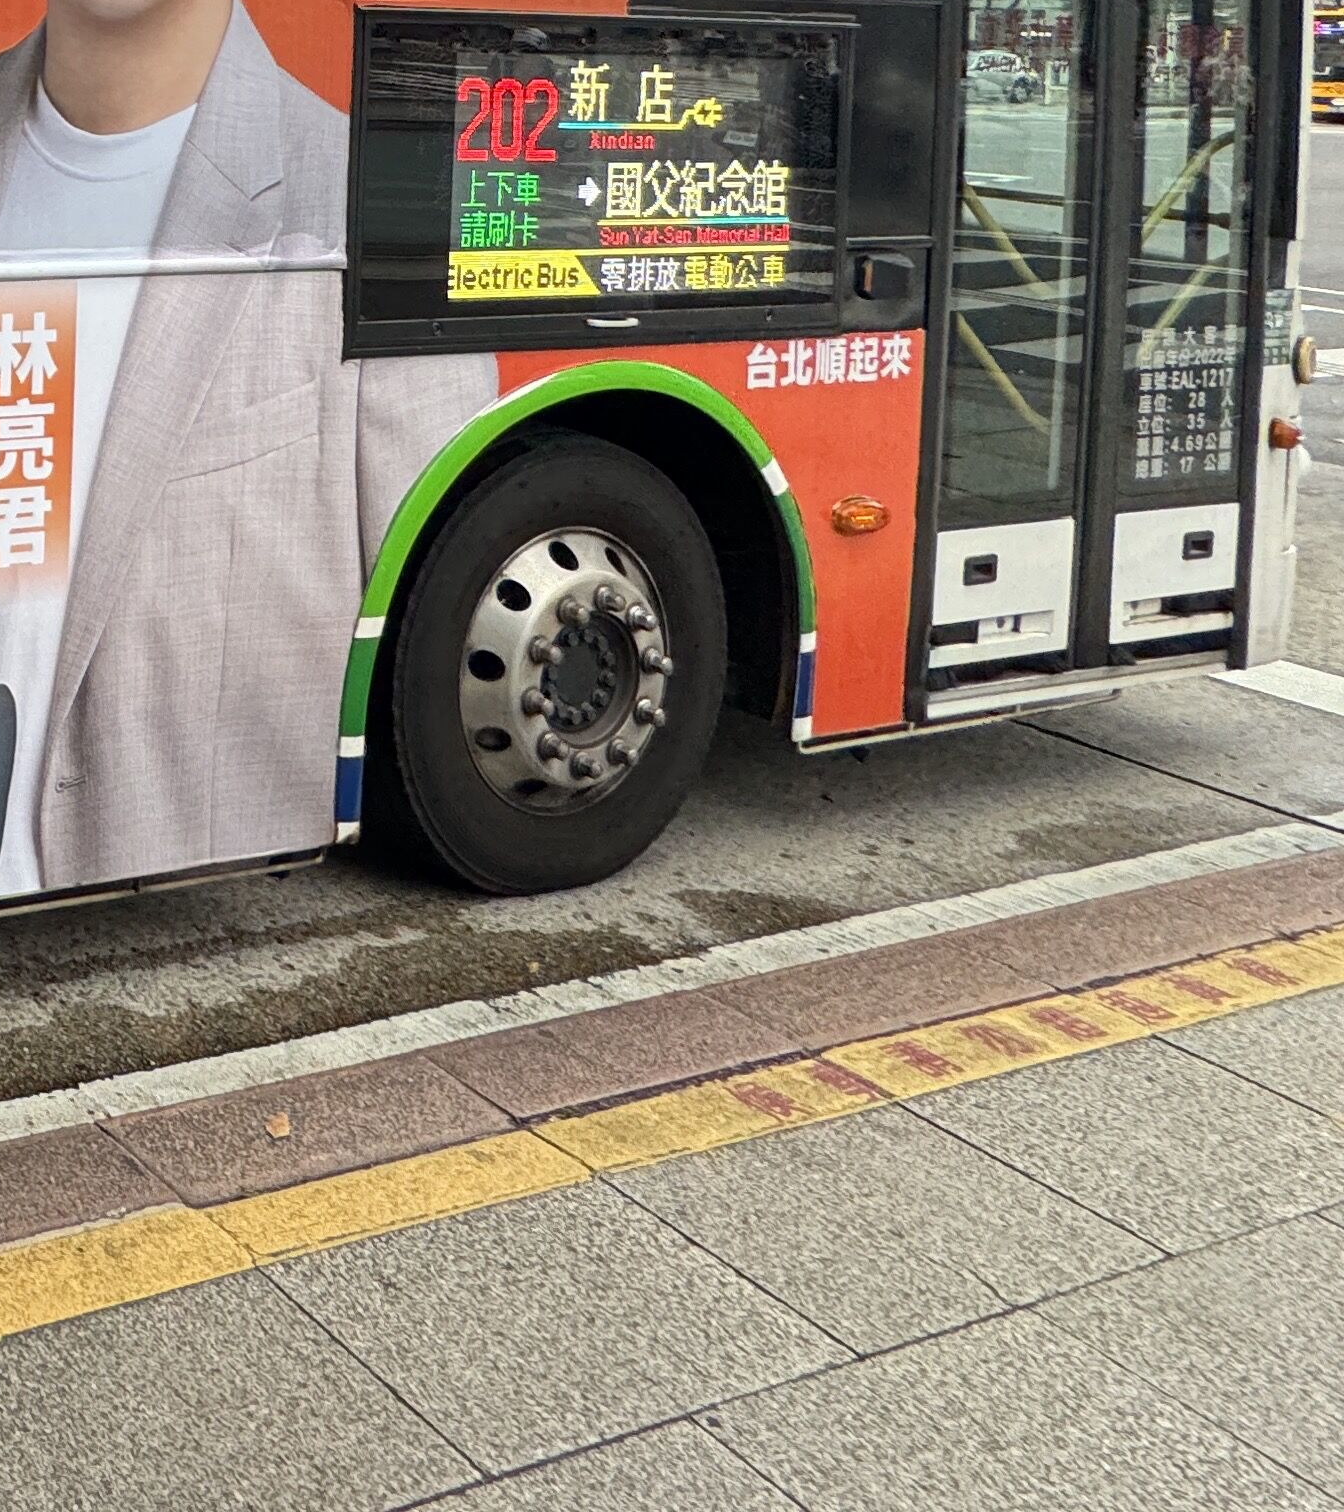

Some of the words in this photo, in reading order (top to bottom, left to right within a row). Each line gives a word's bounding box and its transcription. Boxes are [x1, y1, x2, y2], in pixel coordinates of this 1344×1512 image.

[568, 60, 675, 122] 新店
[457, 77, 559, 162] 202
[588, 132, 657, 151] Xindian
[461, 170, 542, 207] 上下車
[606, 159, 791, 218] 國父紀念館
[460, 210, 540, 248] 請刷卡
[599, 226, 630, 246] Sun
[633, 226, 693, 245] Yat-Sen
[696, 223, 762, 244] Memorial
[764, 223, 791, 243] Hall
[536, 262, 580, 289] Bus
[601, 253, 786, 292] 零排放電動公車
[746, 335, 912, 390] 台北順起來
[1188, 391, 1206, 409] 28
[1220, 388, 1234, 406] 人
[1186, 412, 1206, 430] 35
[1219, 409, 1233, 428] 人
[1179, 455, 1194, 473] 17
